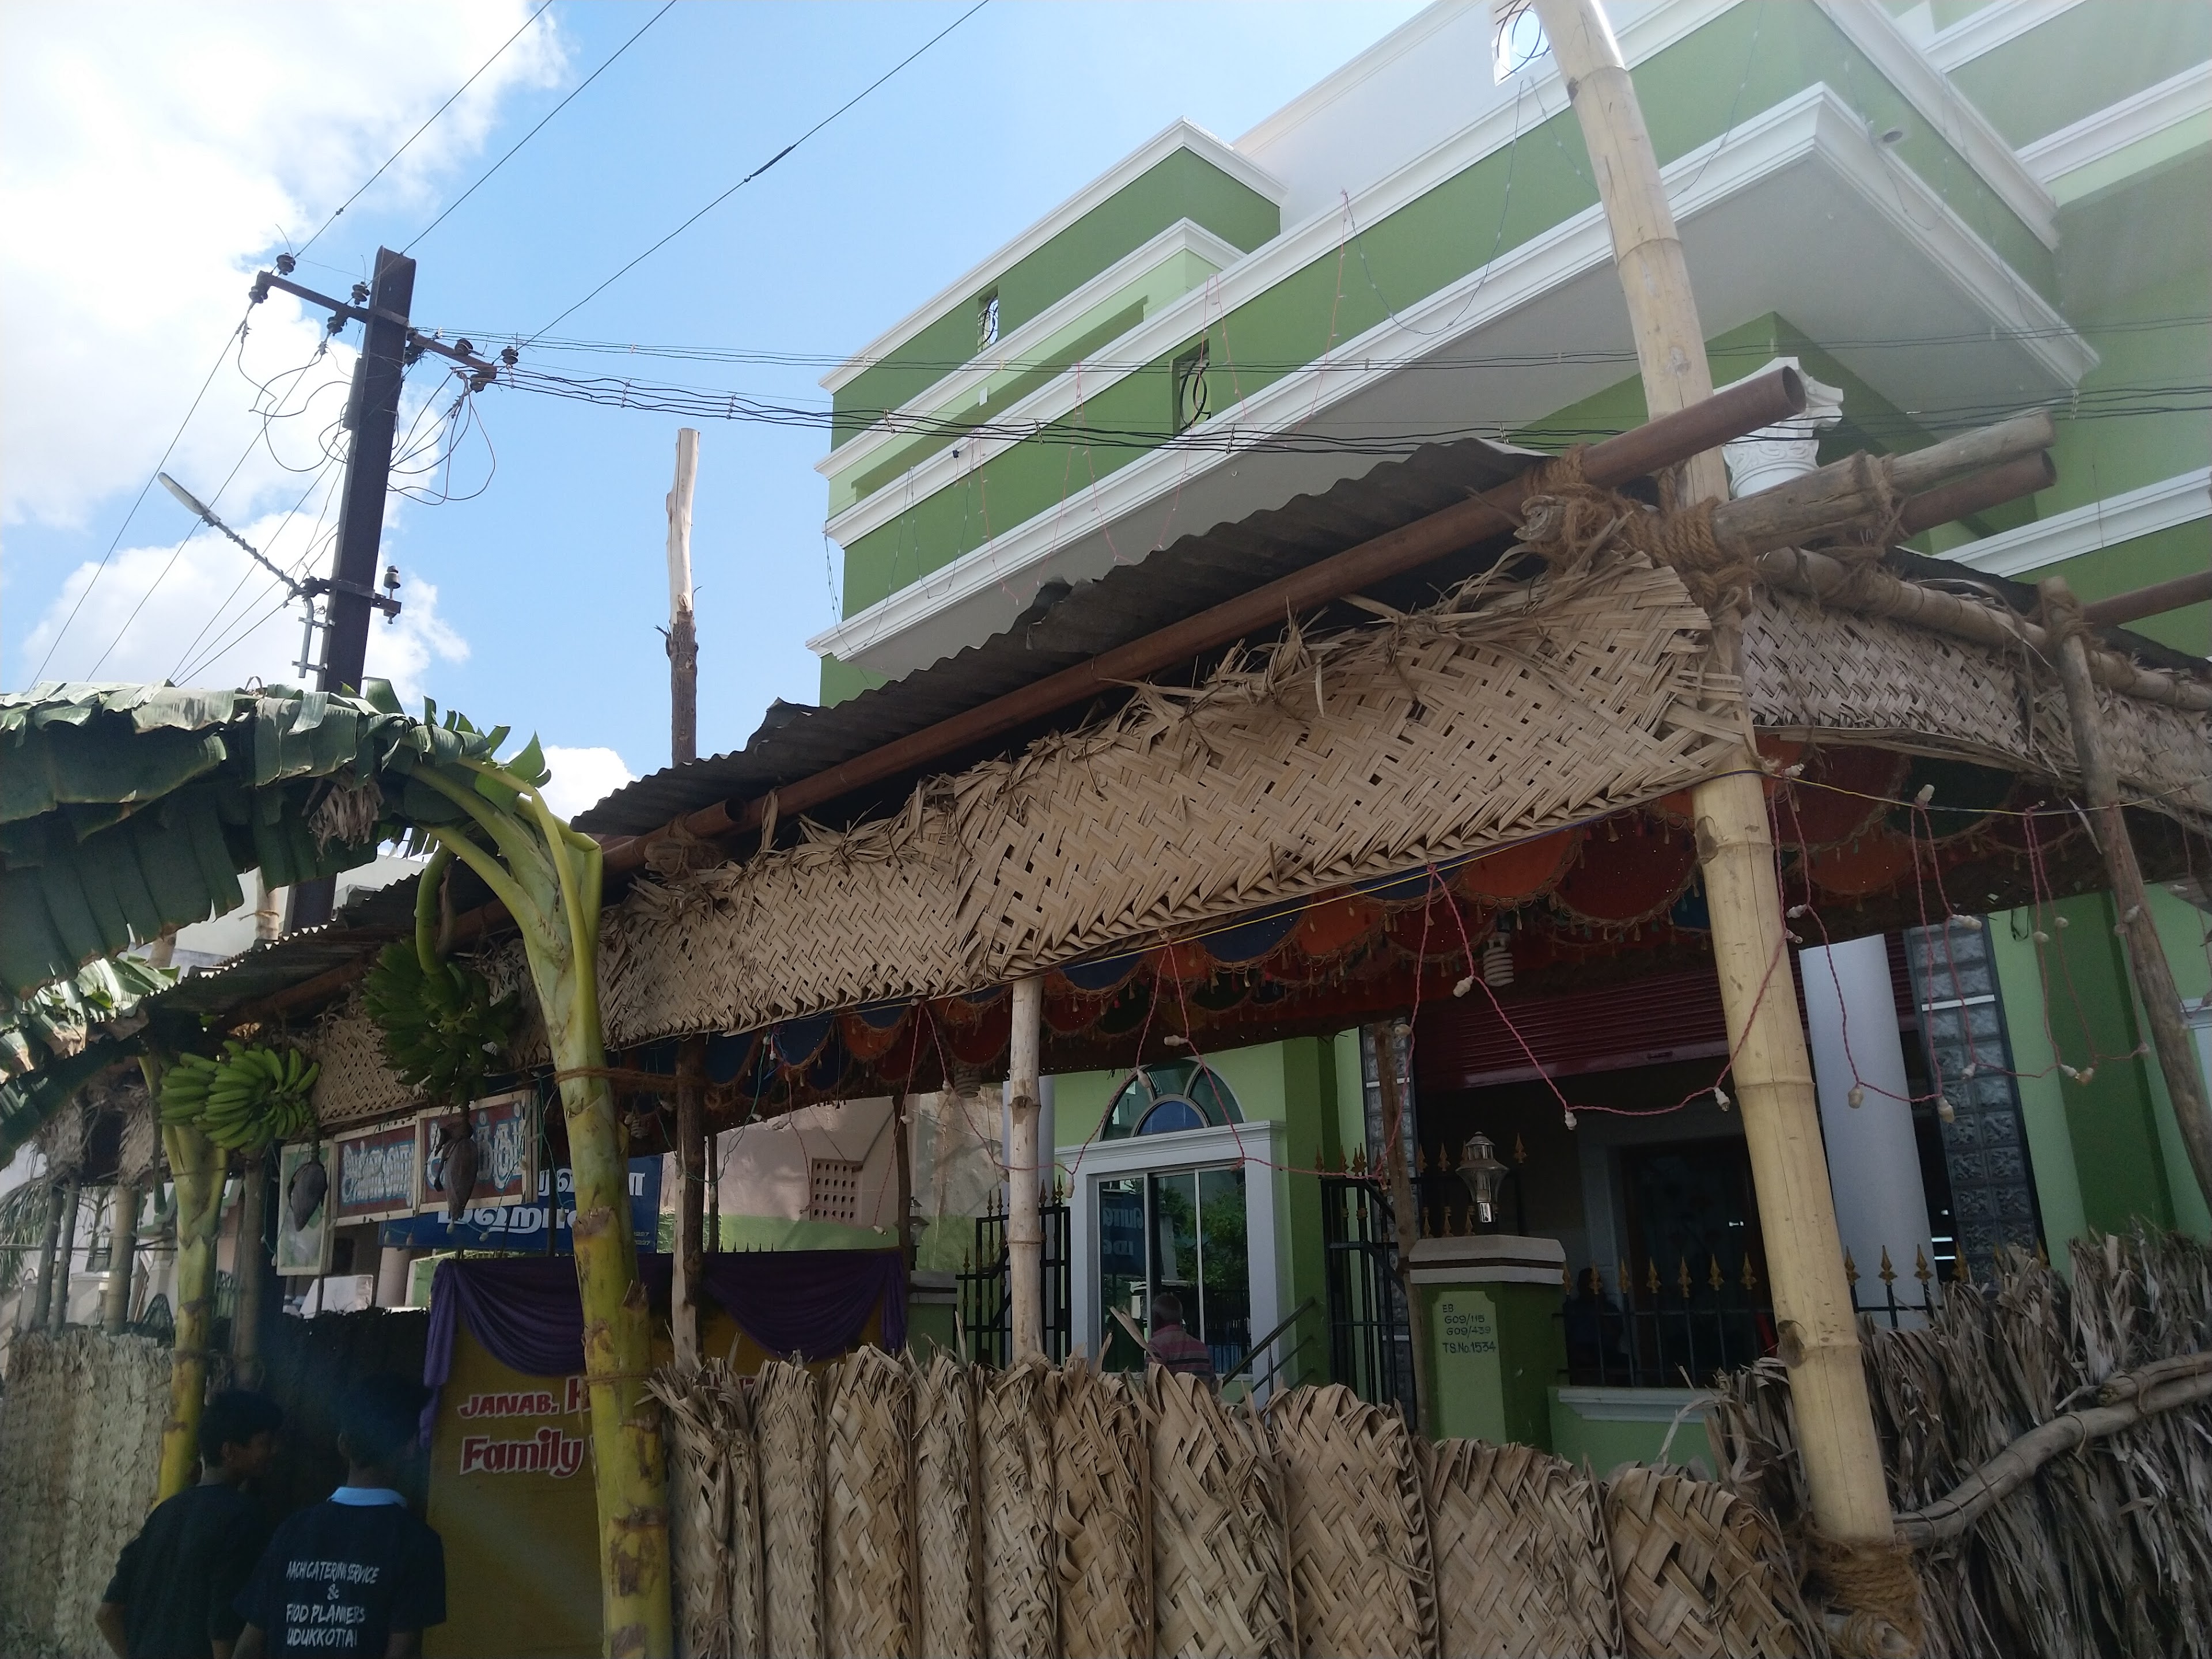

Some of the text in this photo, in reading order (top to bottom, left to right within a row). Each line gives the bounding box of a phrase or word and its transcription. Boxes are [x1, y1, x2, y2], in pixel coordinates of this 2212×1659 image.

[1442, 1304, 1455, 1313] EB
[1445, 1313, 1485, 1325] G09/115
[1446, 1325, 1491, 1338] G09/439
[457, 1391, 560, 1419] JANAB.
[460, 1426, 584, 1479] Family
[327, 1583, 340, 1600] &
